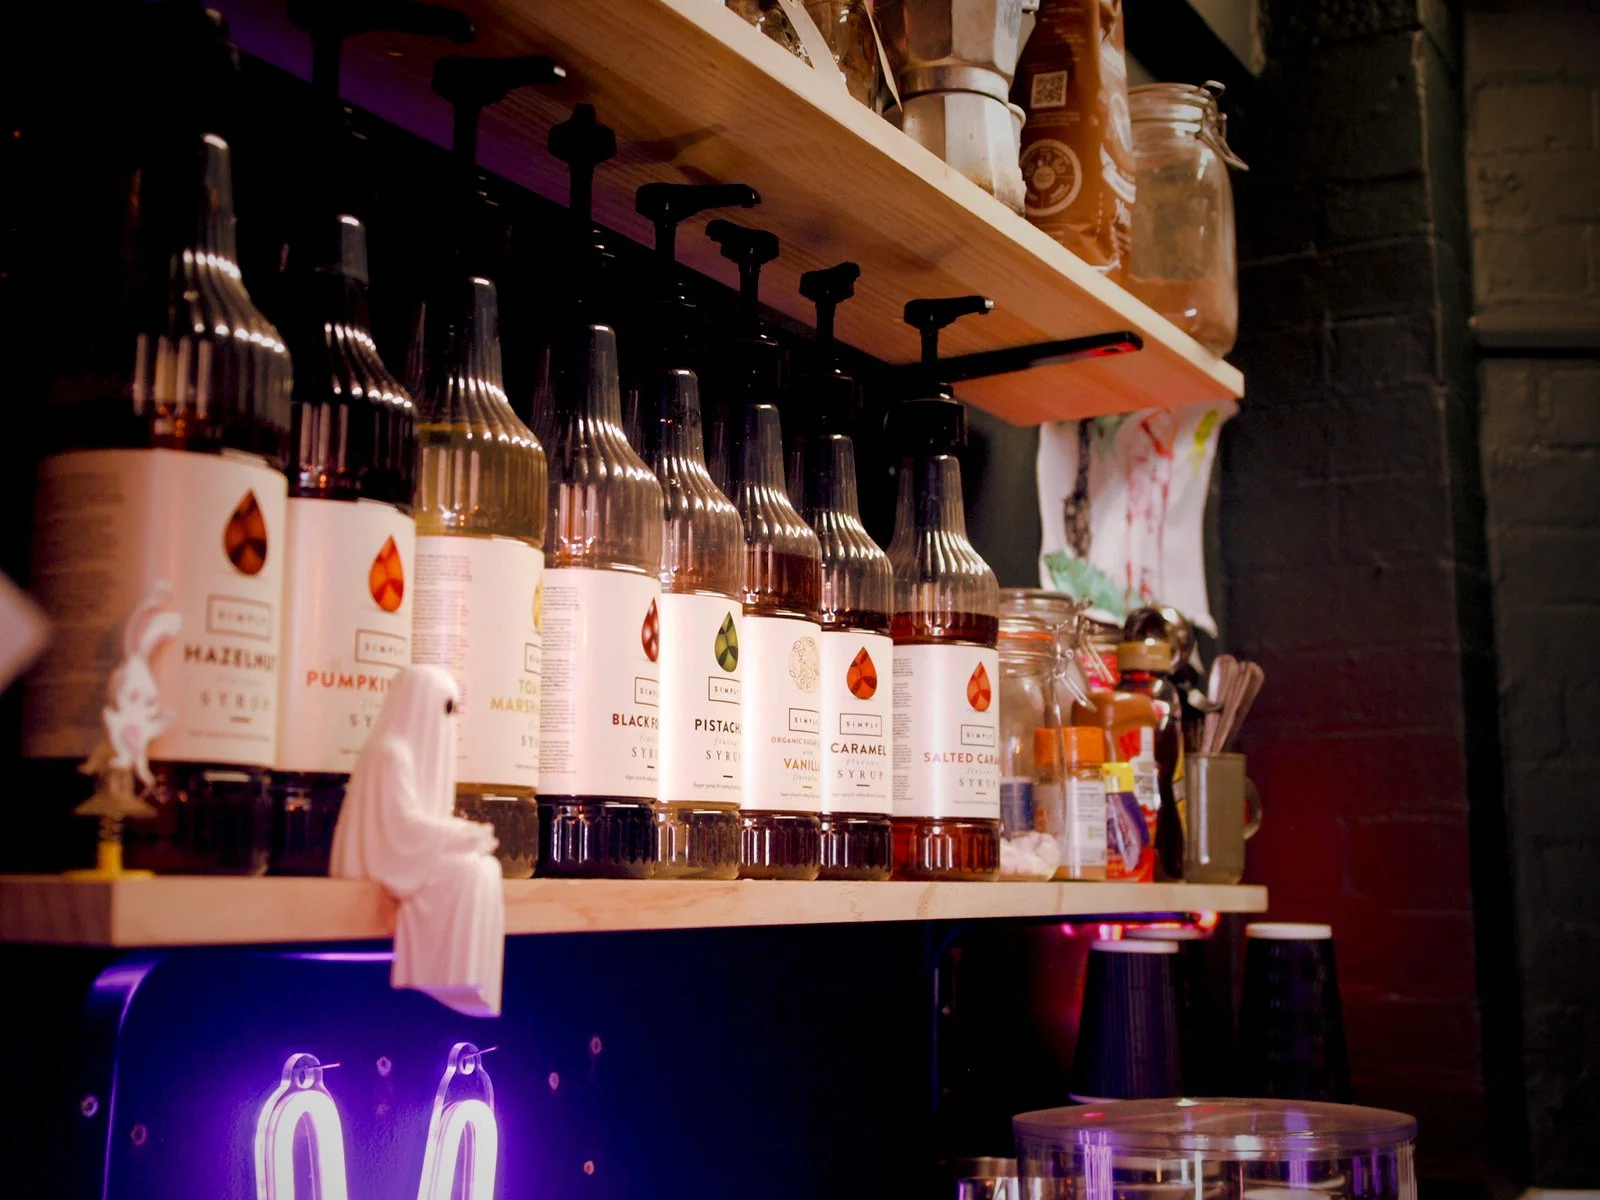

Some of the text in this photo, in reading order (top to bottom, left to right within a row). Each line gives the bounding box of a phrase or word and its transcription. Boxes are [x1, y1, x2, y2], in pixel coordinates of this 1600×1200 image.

[612, 713, 649, 728] BLACK
[695, 718, 742, 735] PISTACH
[830, 742, 887, 756] CARAMEL
[924, 752, 974, 763] SALTED
